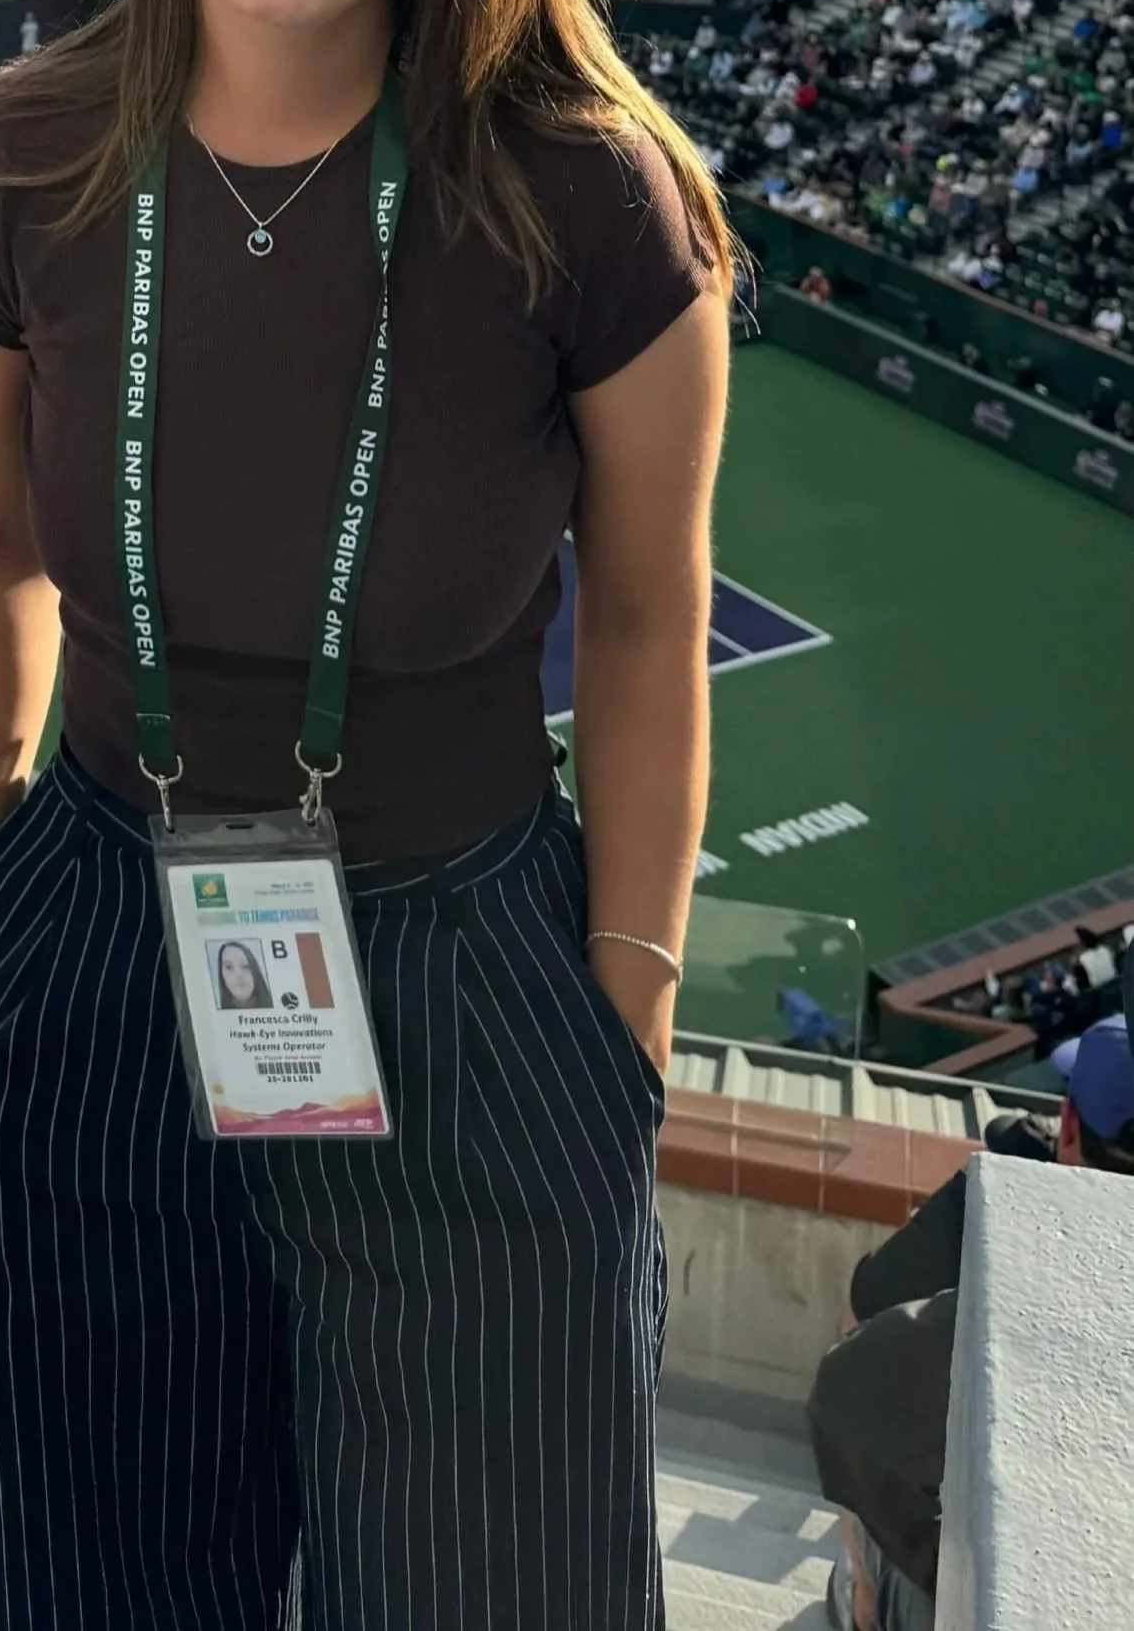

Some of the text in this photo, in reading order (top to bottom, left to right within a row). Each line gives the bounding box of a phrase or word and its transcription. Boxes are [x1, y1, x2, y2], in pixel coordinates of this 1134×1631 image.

[127, 193, 154, 418] BNP PARIBAS OPEN
[368, 357, 386, 408] BNP
[377, 181, 397, 243] OPEN
[124, 439, 156, 667] BNP PARIBAS OPEN
[321, 429, 377, 659] BNP PARIBAS OPEN
[271, 939, 288, 959] B
[229, 1029, 334, 1039] Hawk-Eye Innovations
[238, 1015, 289, 1025] Francesca
[243, 1042, 326, 1053] Systems Operator
